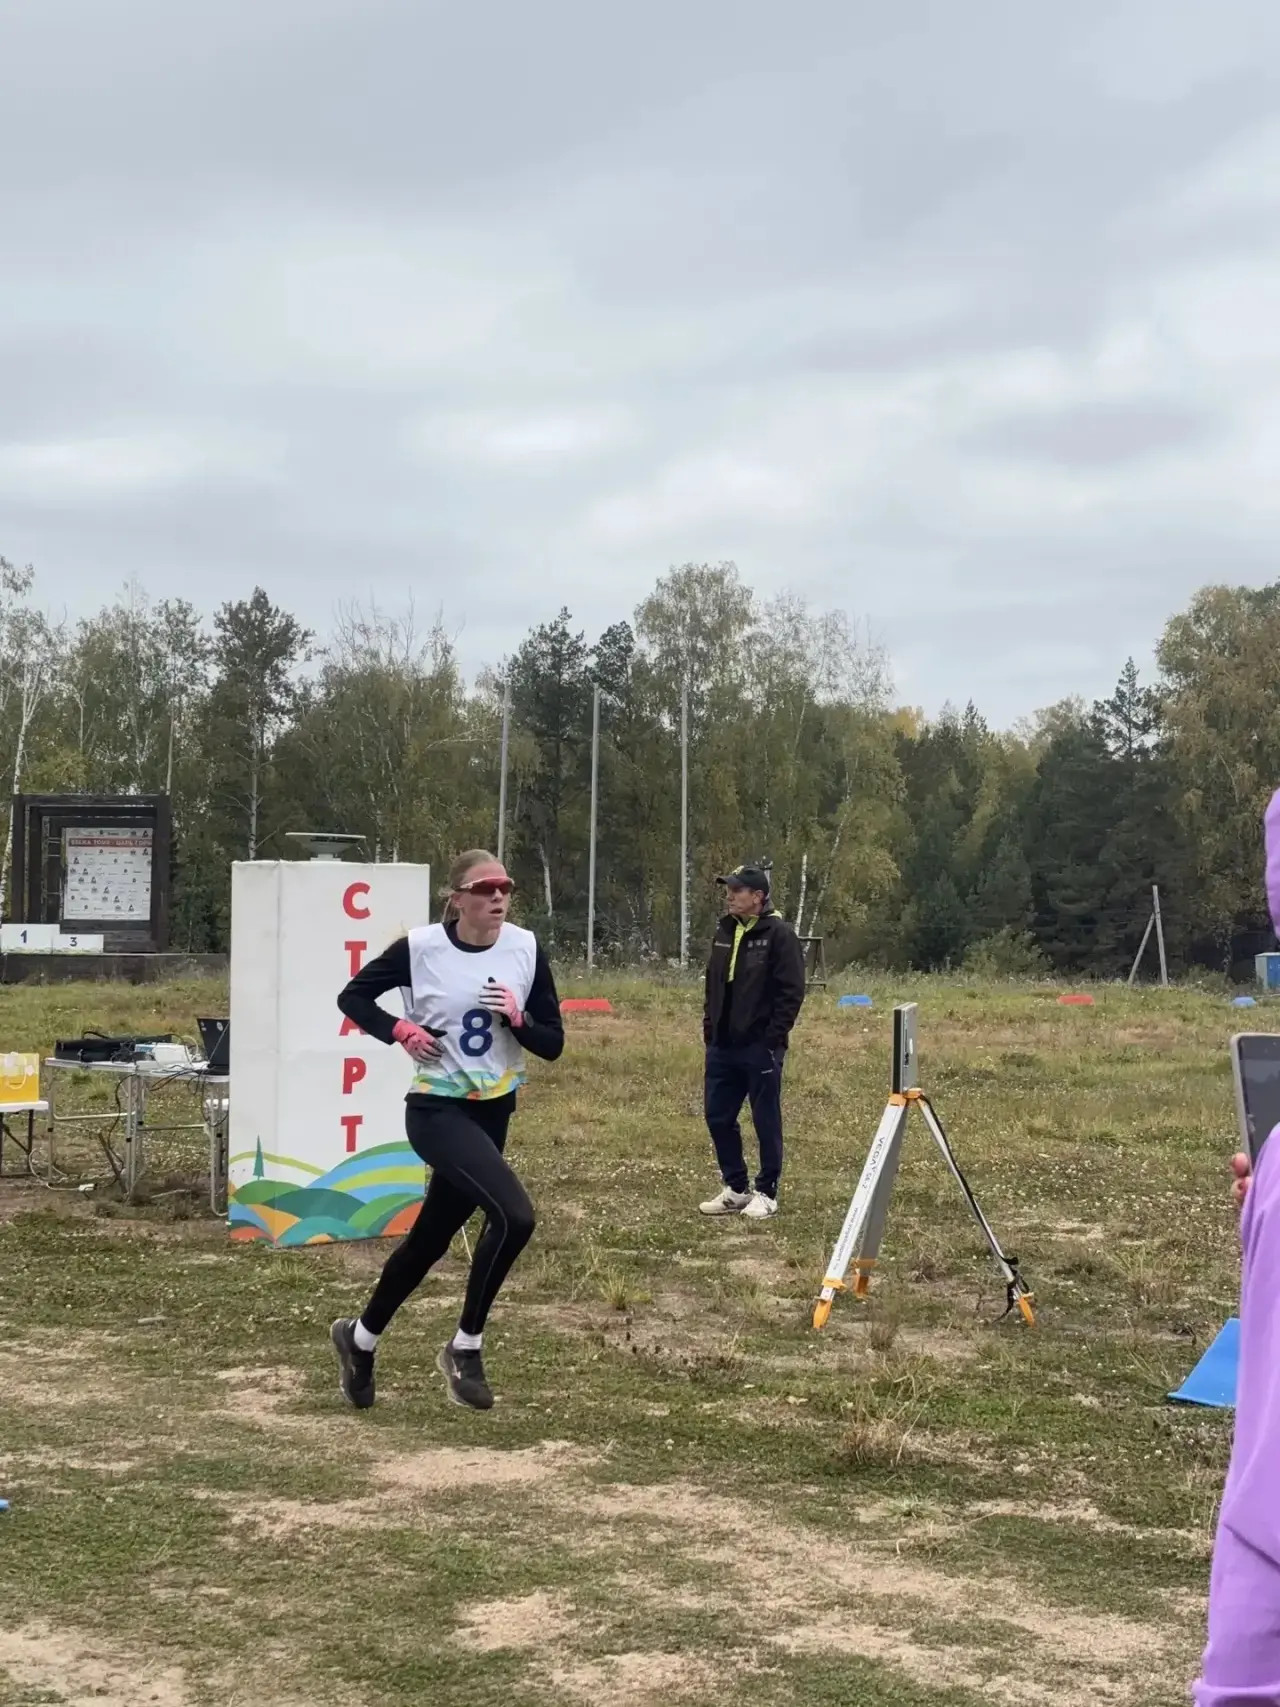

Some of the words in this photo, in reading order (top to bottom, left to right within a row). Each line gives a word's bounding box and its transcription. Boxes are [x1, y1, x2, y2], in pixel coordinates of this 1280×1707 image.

[20, 929, 28, 944] 1
[69, 936, 78, 947] 3
[459, 1008, 493, 1057] 8
[869, 1136, 886, 1166] VEGA
